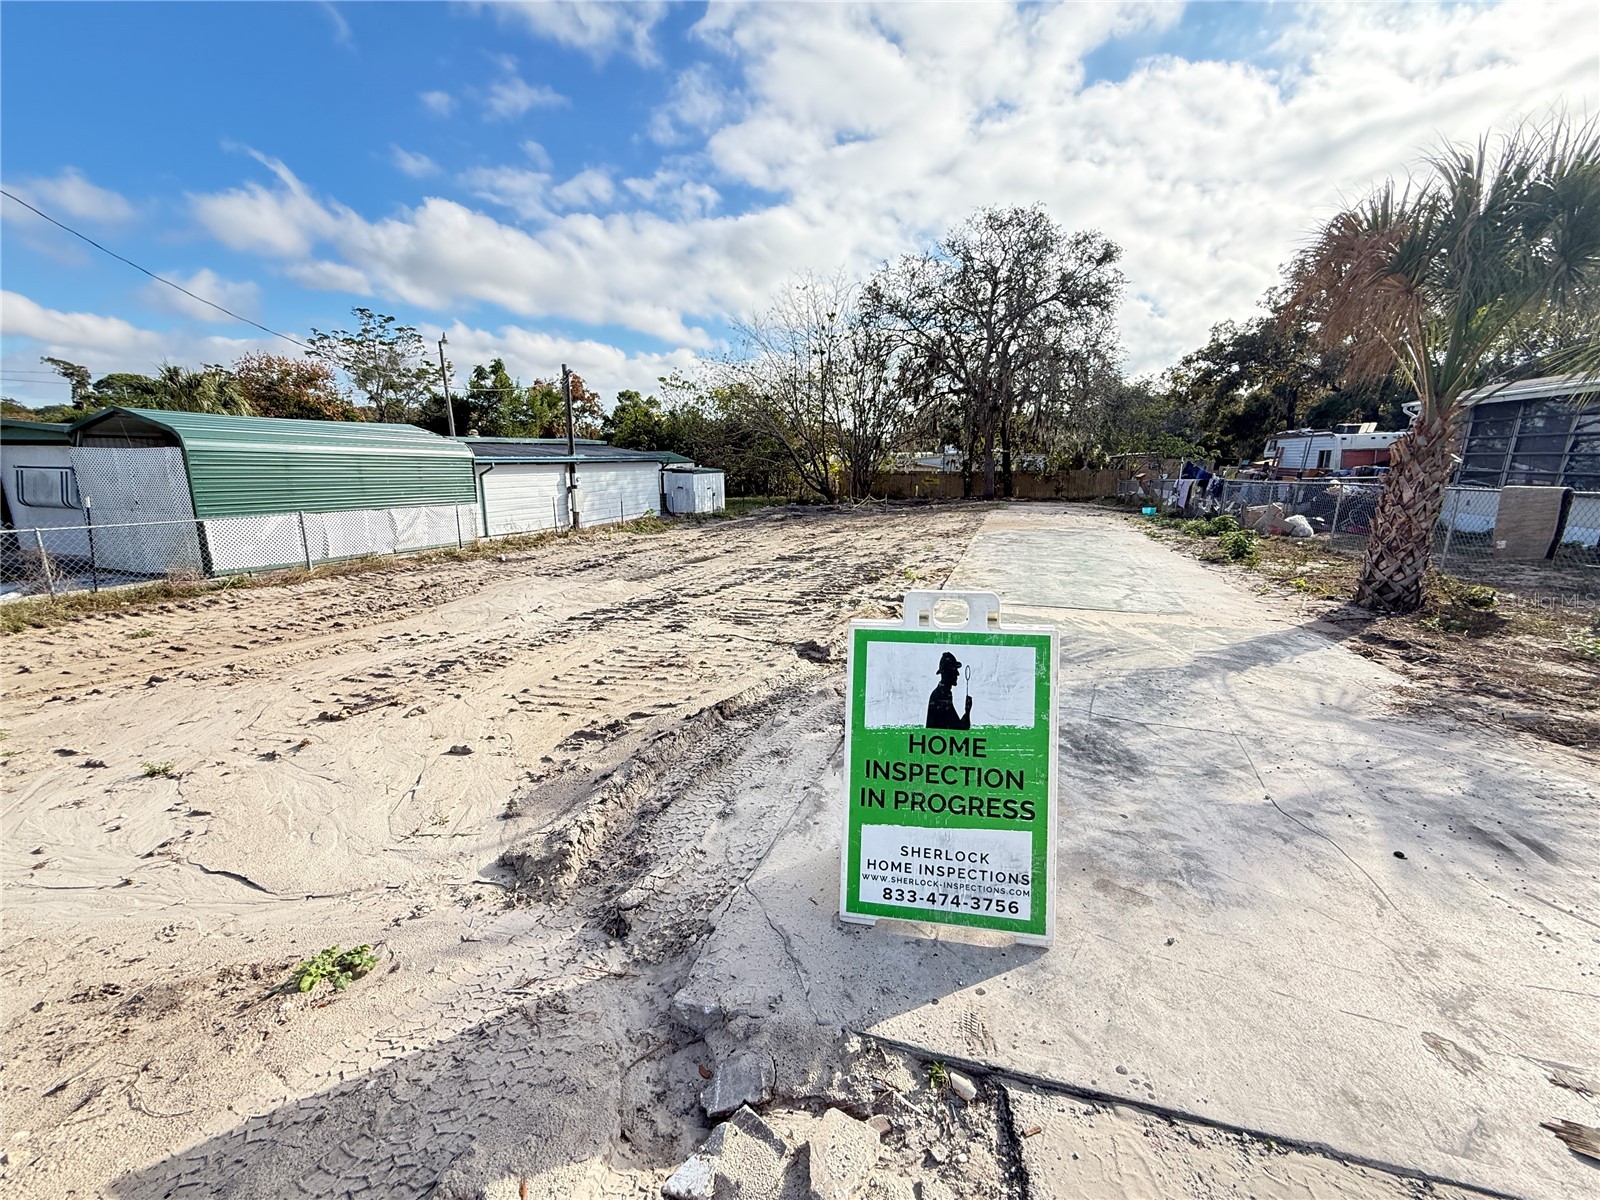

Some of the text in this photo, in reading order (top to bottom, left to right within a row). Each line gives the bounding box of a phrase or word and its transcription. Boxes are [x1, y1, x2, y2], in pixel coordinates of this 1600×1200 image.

[908, 733, 987, 758] HOME
[865, 759, 1024, 790] INSPECTION
[860, 787, 1036, 821] IN PROGRESS
[900, 846, 990, 864] SHERLOCK
[861, 873, 1031, 897] WWW.SHERLOCK-INSPECTIONS.COM
[866, 858, 1030, 886] HOME INSPECTIONS
[882, 887, 1020, 914] 833-474-3756
